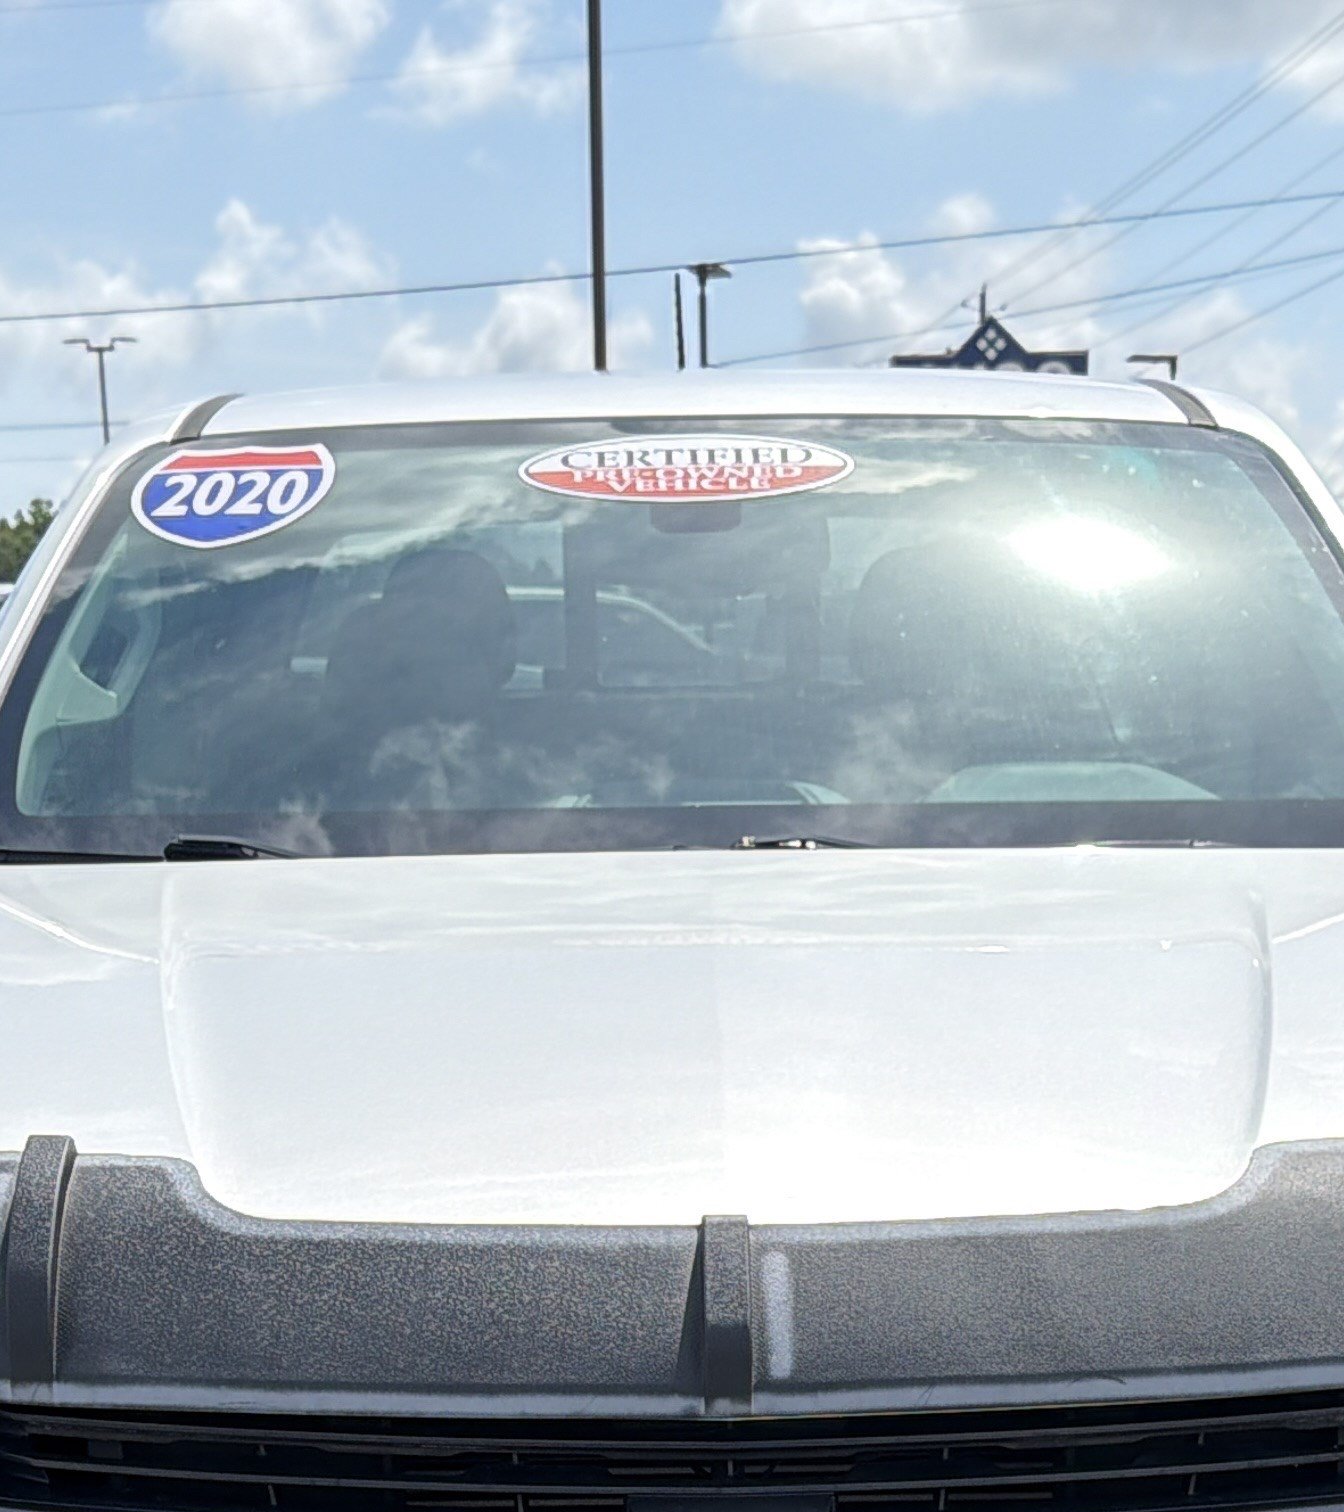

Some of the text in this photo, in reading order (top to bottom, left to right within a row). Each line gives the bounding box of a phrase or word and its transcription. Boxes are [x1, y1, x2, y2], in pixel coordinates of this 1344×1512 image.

[560, 446, 813, 470] CERTIFIED
[150, 470, 309, 517] 2020
[606, 477, 772, 493] VEHICLE
